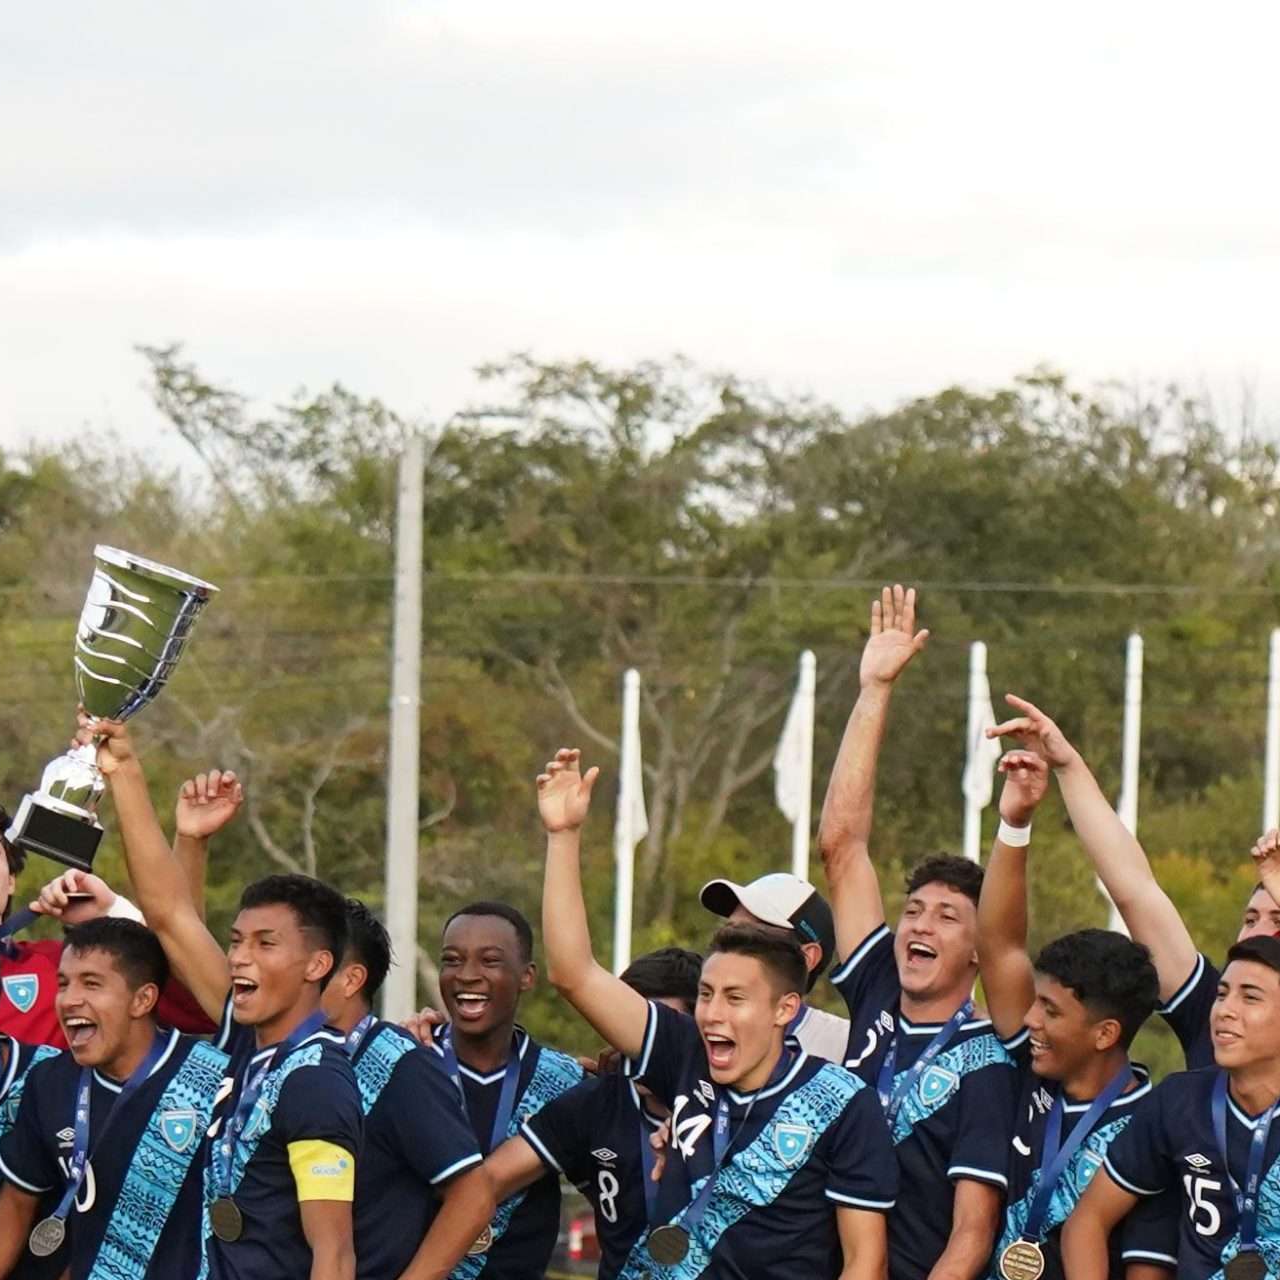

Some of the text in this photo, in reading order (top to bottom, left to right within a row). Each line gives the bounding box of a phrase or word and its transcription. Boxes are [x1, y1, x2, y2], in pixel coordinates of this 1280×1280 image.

[671, 1094, 713, 1163] 14
[598, 1170, 620, 1223] 8
[1183, 1174, 1222, 1236] 15
